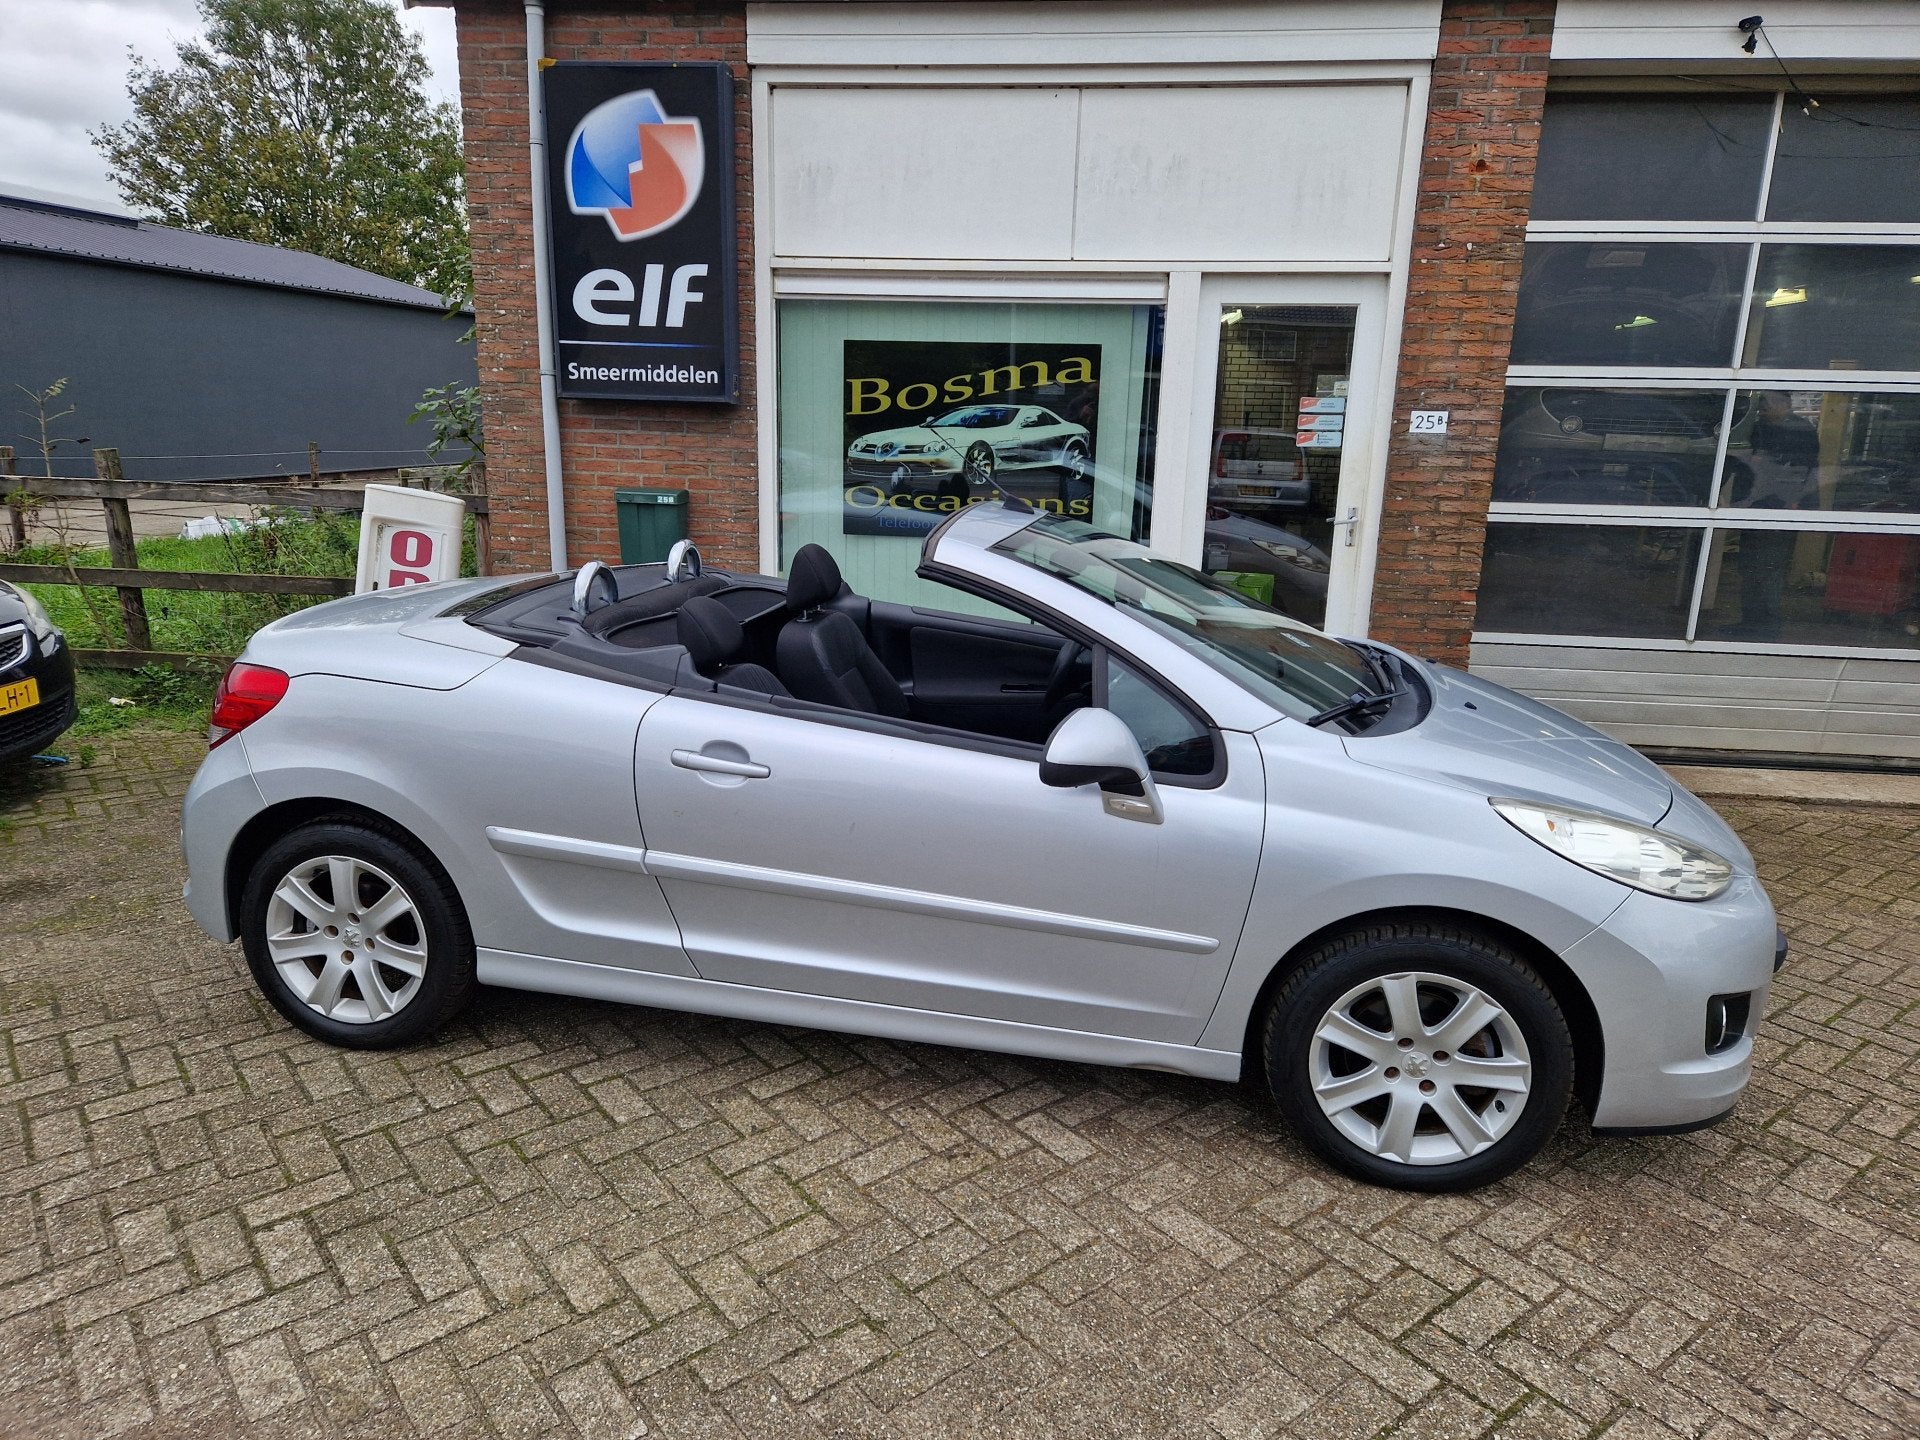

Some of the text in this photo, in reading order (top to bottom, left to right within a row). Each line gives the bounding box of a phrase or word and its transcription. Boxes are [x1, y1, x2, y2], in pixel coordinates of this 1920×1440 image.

[572, 263, 709, 328] elf
[567, 362, 718, 385] Smeermiddelen
[845, 356, 1098, 416] Bosma
[1415, 414, 1444, 430] 25B
